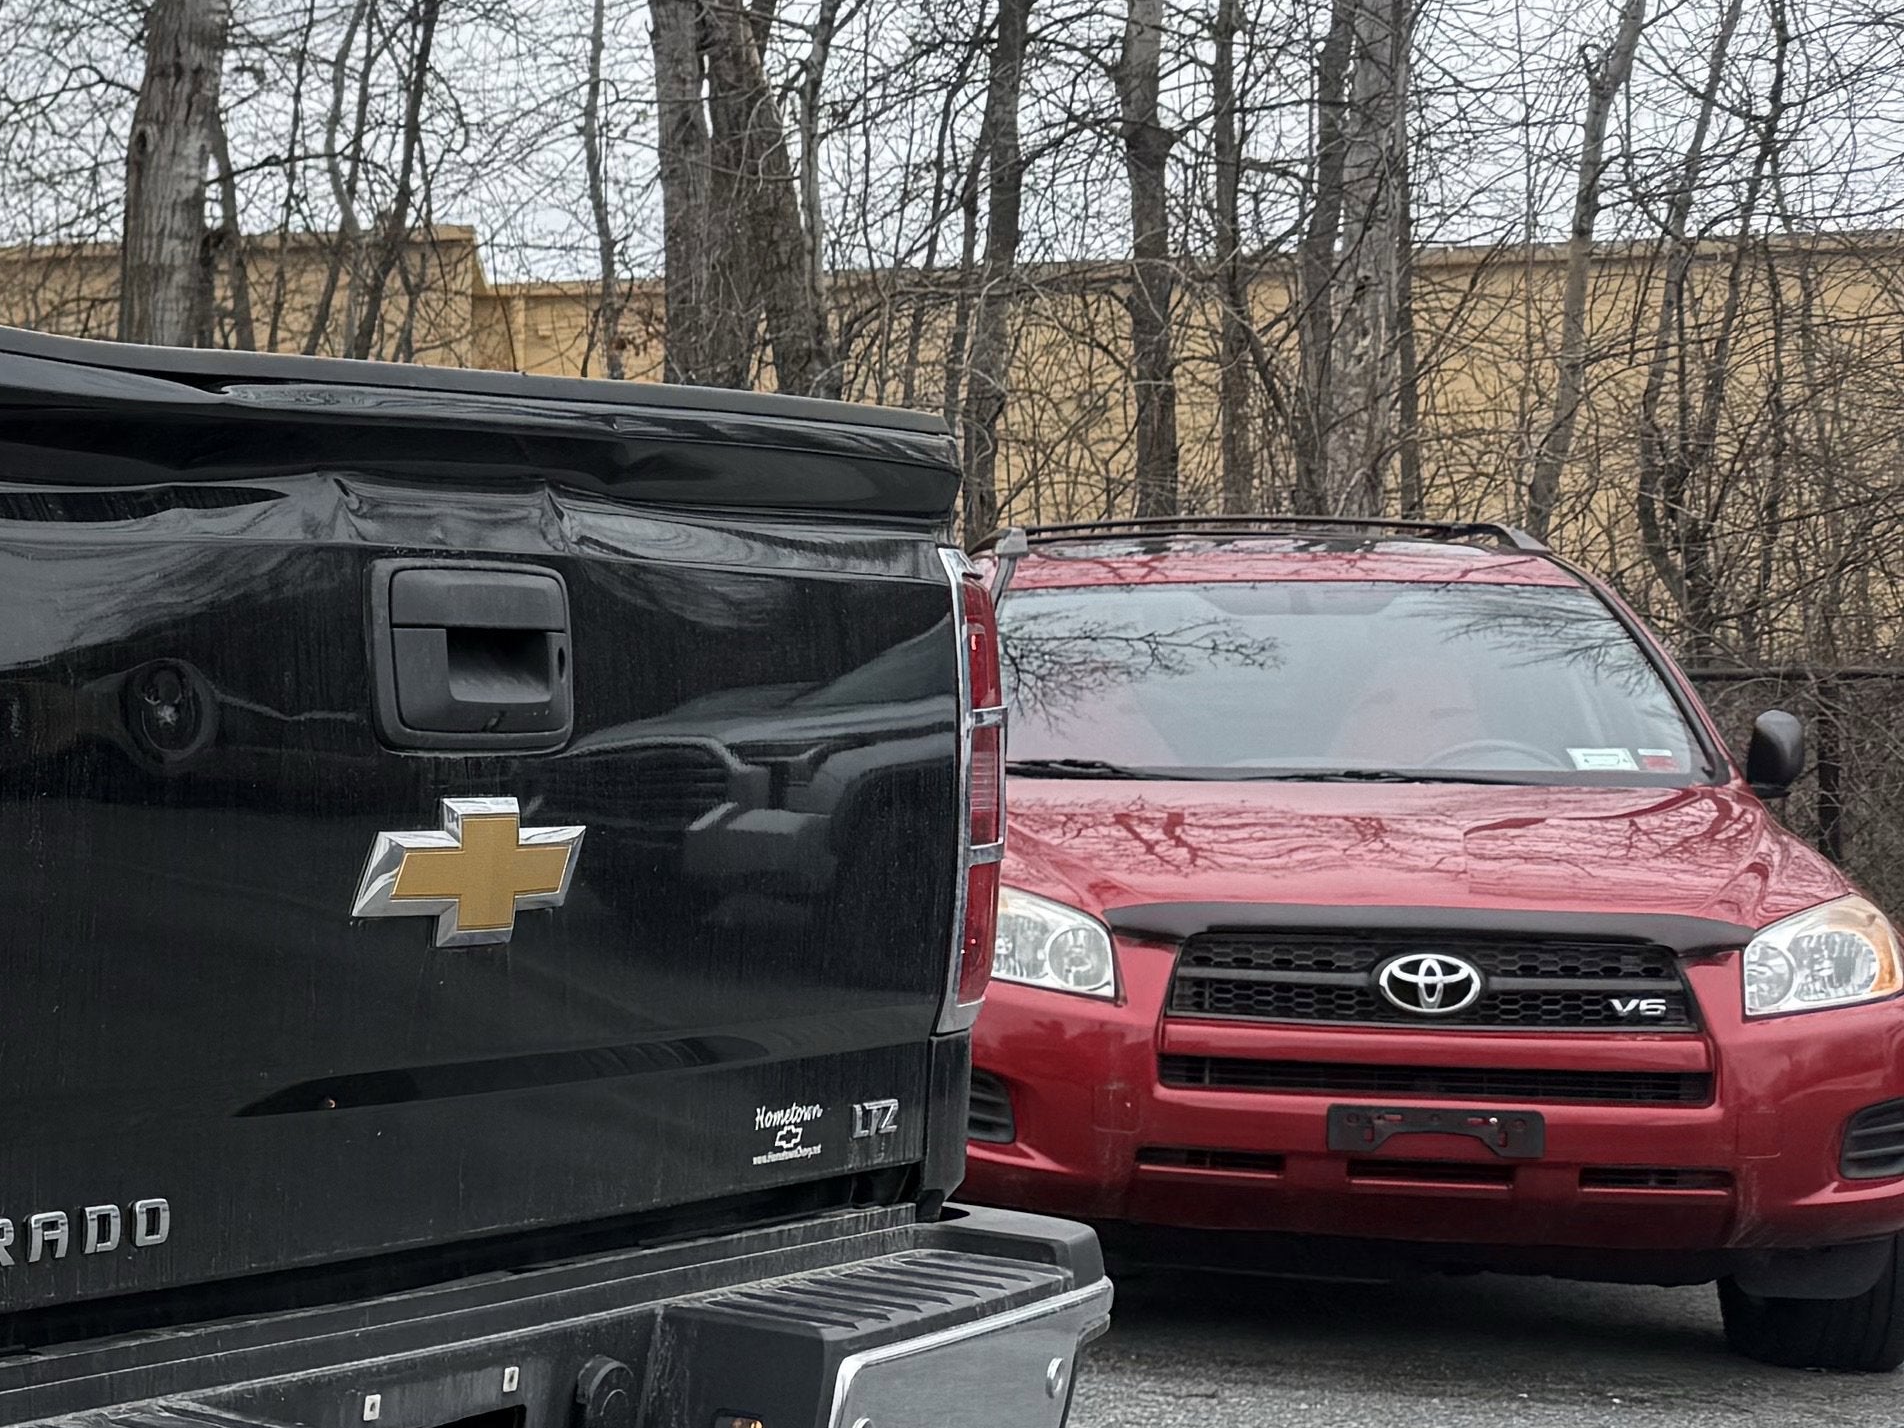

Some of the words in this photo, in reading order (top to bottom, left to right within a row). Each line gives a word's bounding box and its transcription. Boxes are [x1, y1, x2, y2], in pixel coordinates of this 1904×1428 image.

[1608, 998, 1667, 1016] V6
[755, 1102, 823, 1130] Hometown
[852, 1098, 898, 1138] LTZ
